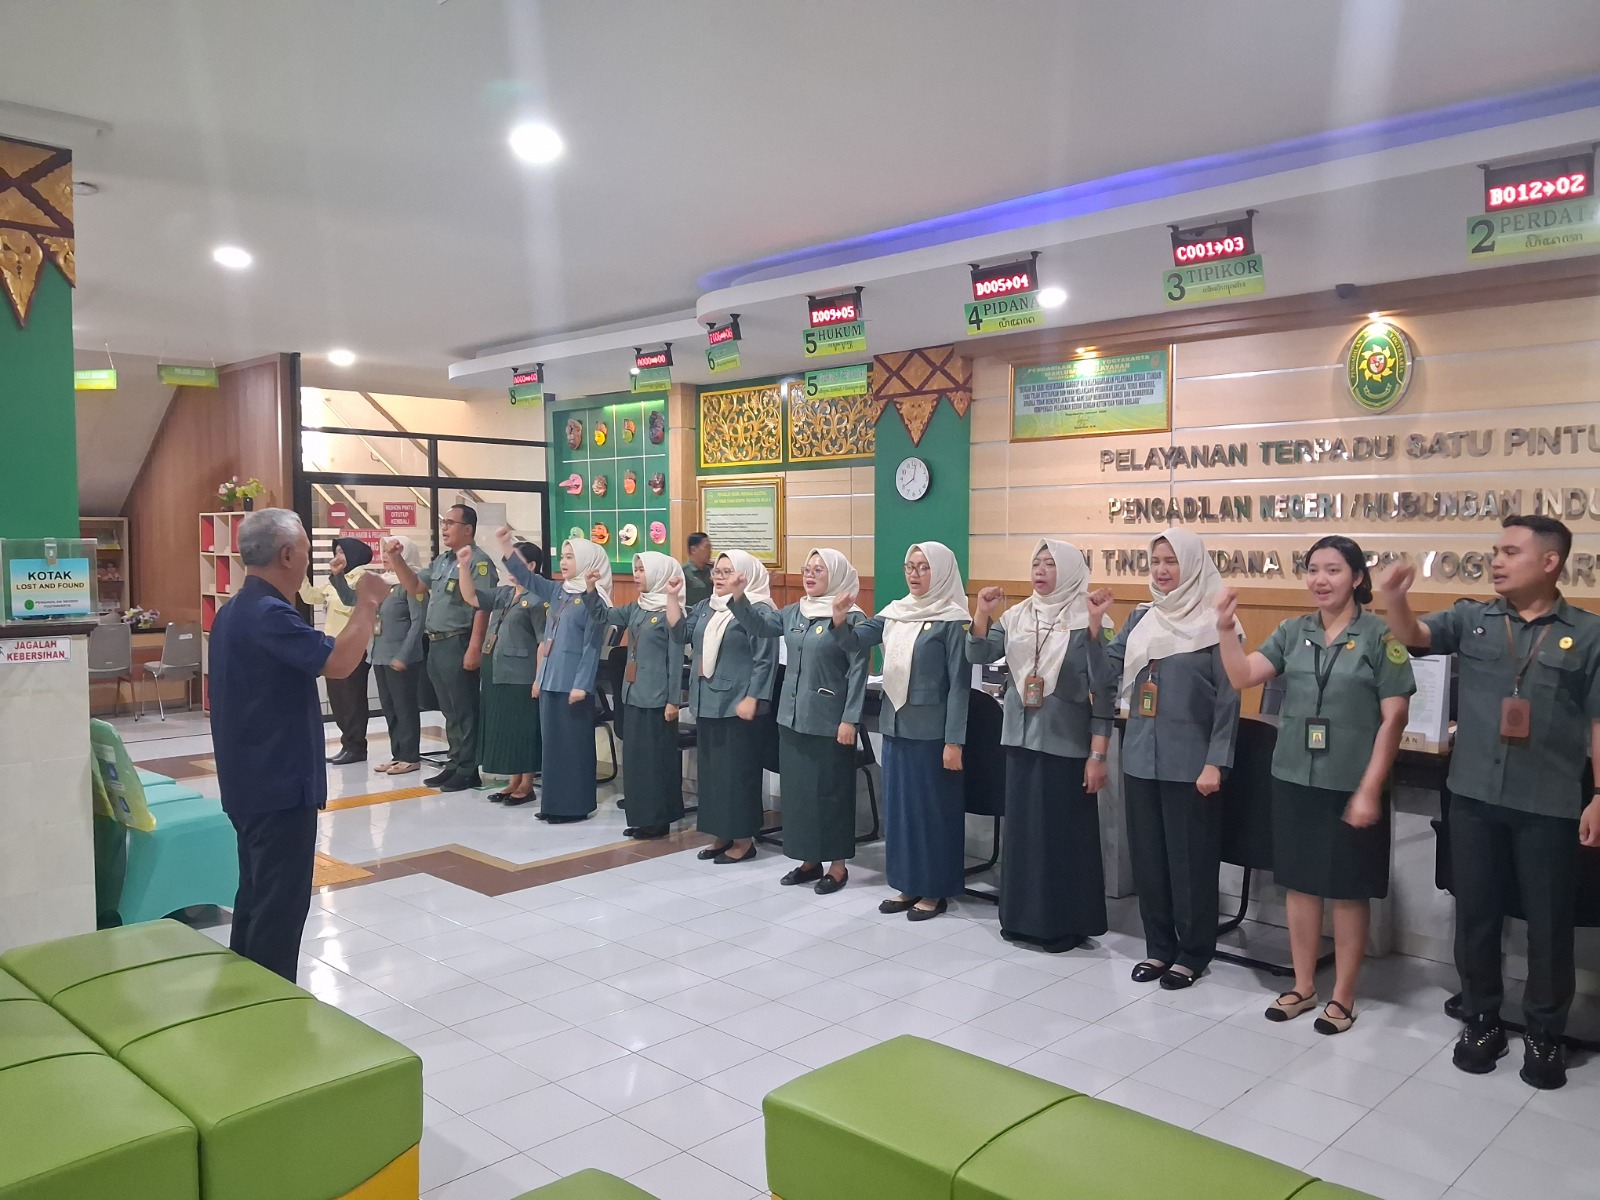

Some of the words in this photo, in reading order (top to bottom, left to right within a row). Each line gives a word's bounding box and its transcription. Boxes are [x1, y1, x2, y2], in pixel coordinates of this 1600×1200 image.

[1500, 204, 1592, 233] PERDAT
[1471, 219, 1496, 254] 2
[1186, 260, 1260, 283] TIPIKOR
[1166, 272, 1186, 301] 3
[968, 306, 983, 330] 4
[806, 332, 818, 354] 5
[818, 325, 862, 341] HUKUM
[708, 351, 716, 370] 6
[630, 374, 637, 390] 7
[807, 376, 818, 396] 5
[510, 390, 516, 405] 8
[1100, 442, 1248, 471] PELAYANAN
[1257, 434, 1396, 465] TERPADU
[1405, 428, 1496, 459] SATU
[1108, 494, 1252, 523] PENGADILAN
[1260, 492, 1342, 522] NEGERI
[1101, 549, 1150, 576] TIND
[28, 570, 72, 580] KOTAK
[6, 650, 65, 661] KEBERSIHAN
[14, 640, 57, 650] JAGALAH
